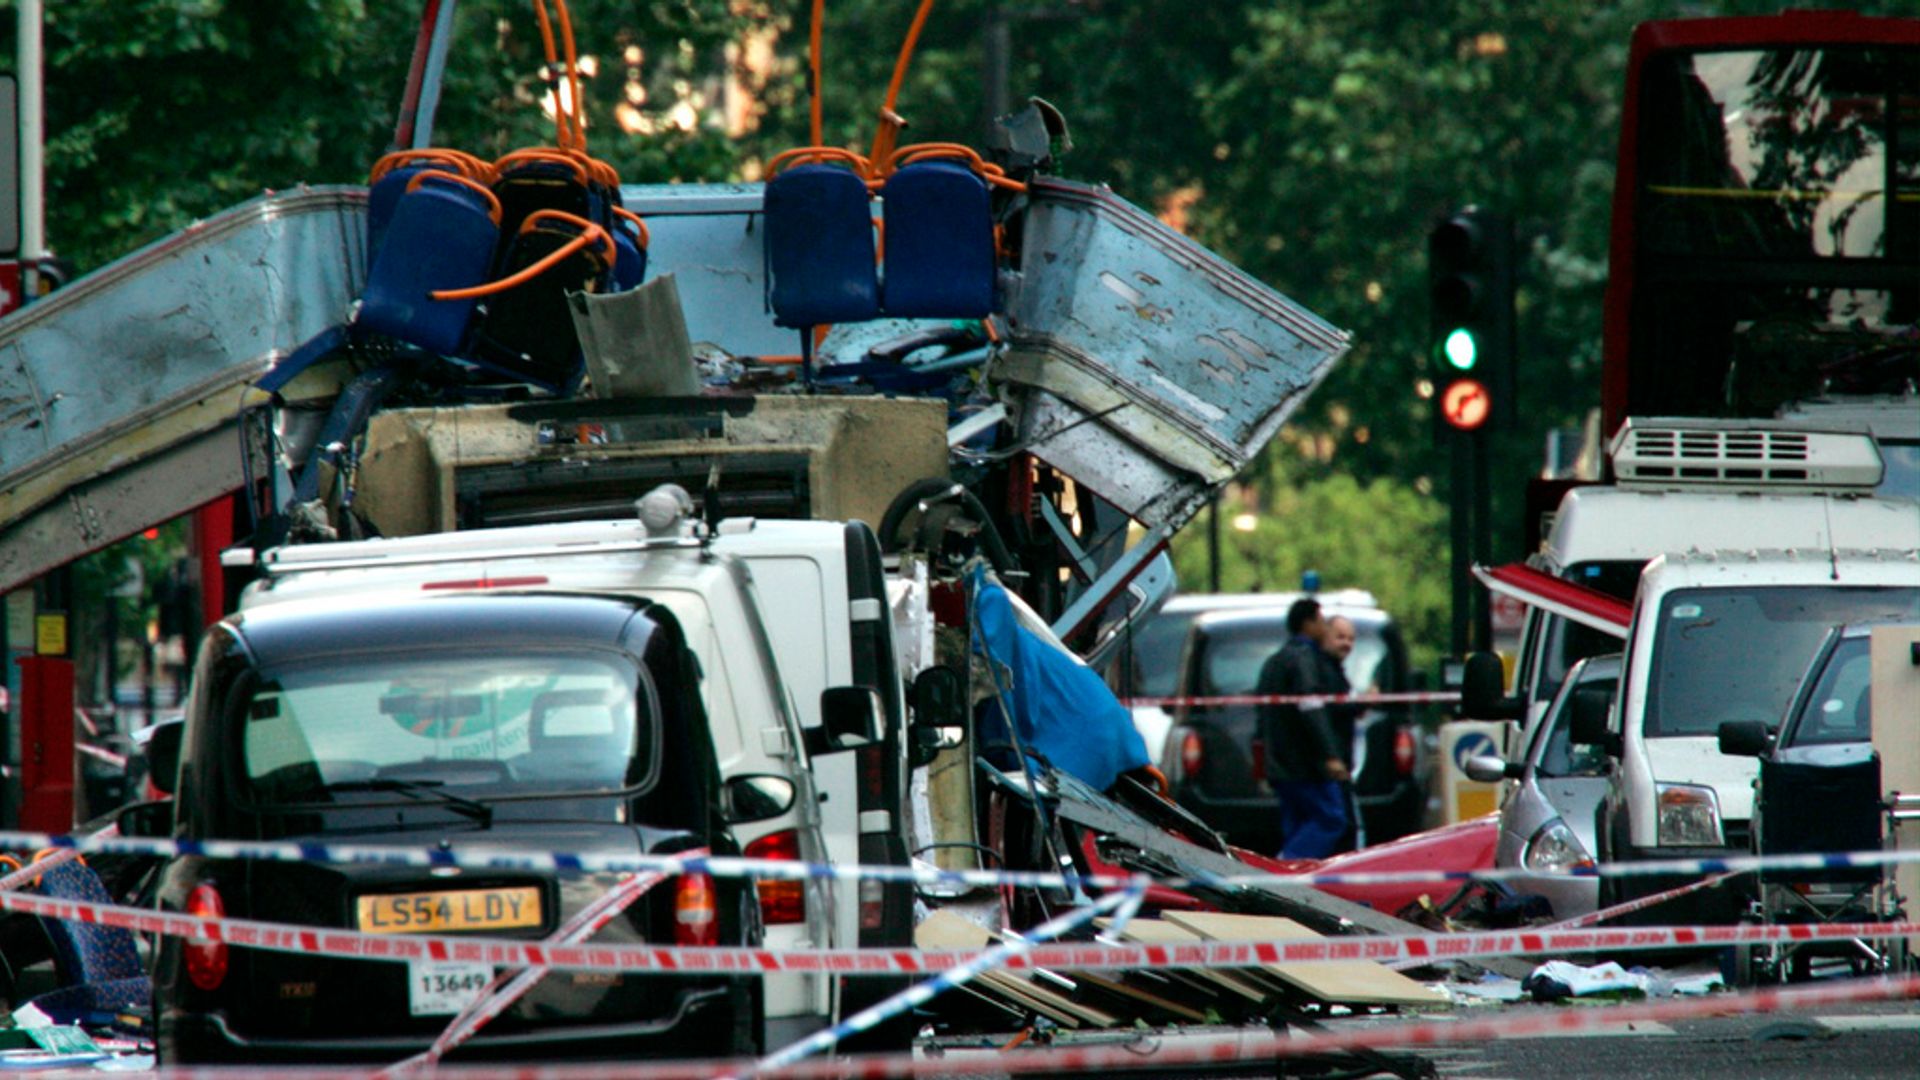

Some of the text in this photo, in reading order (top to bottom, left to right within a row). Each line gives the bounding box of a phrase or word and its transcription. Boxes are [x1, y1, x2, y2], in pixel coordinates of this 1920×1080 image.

[366, 893, 523, 927] LS54 LDY
[423, 973, 485, 993] 13649
